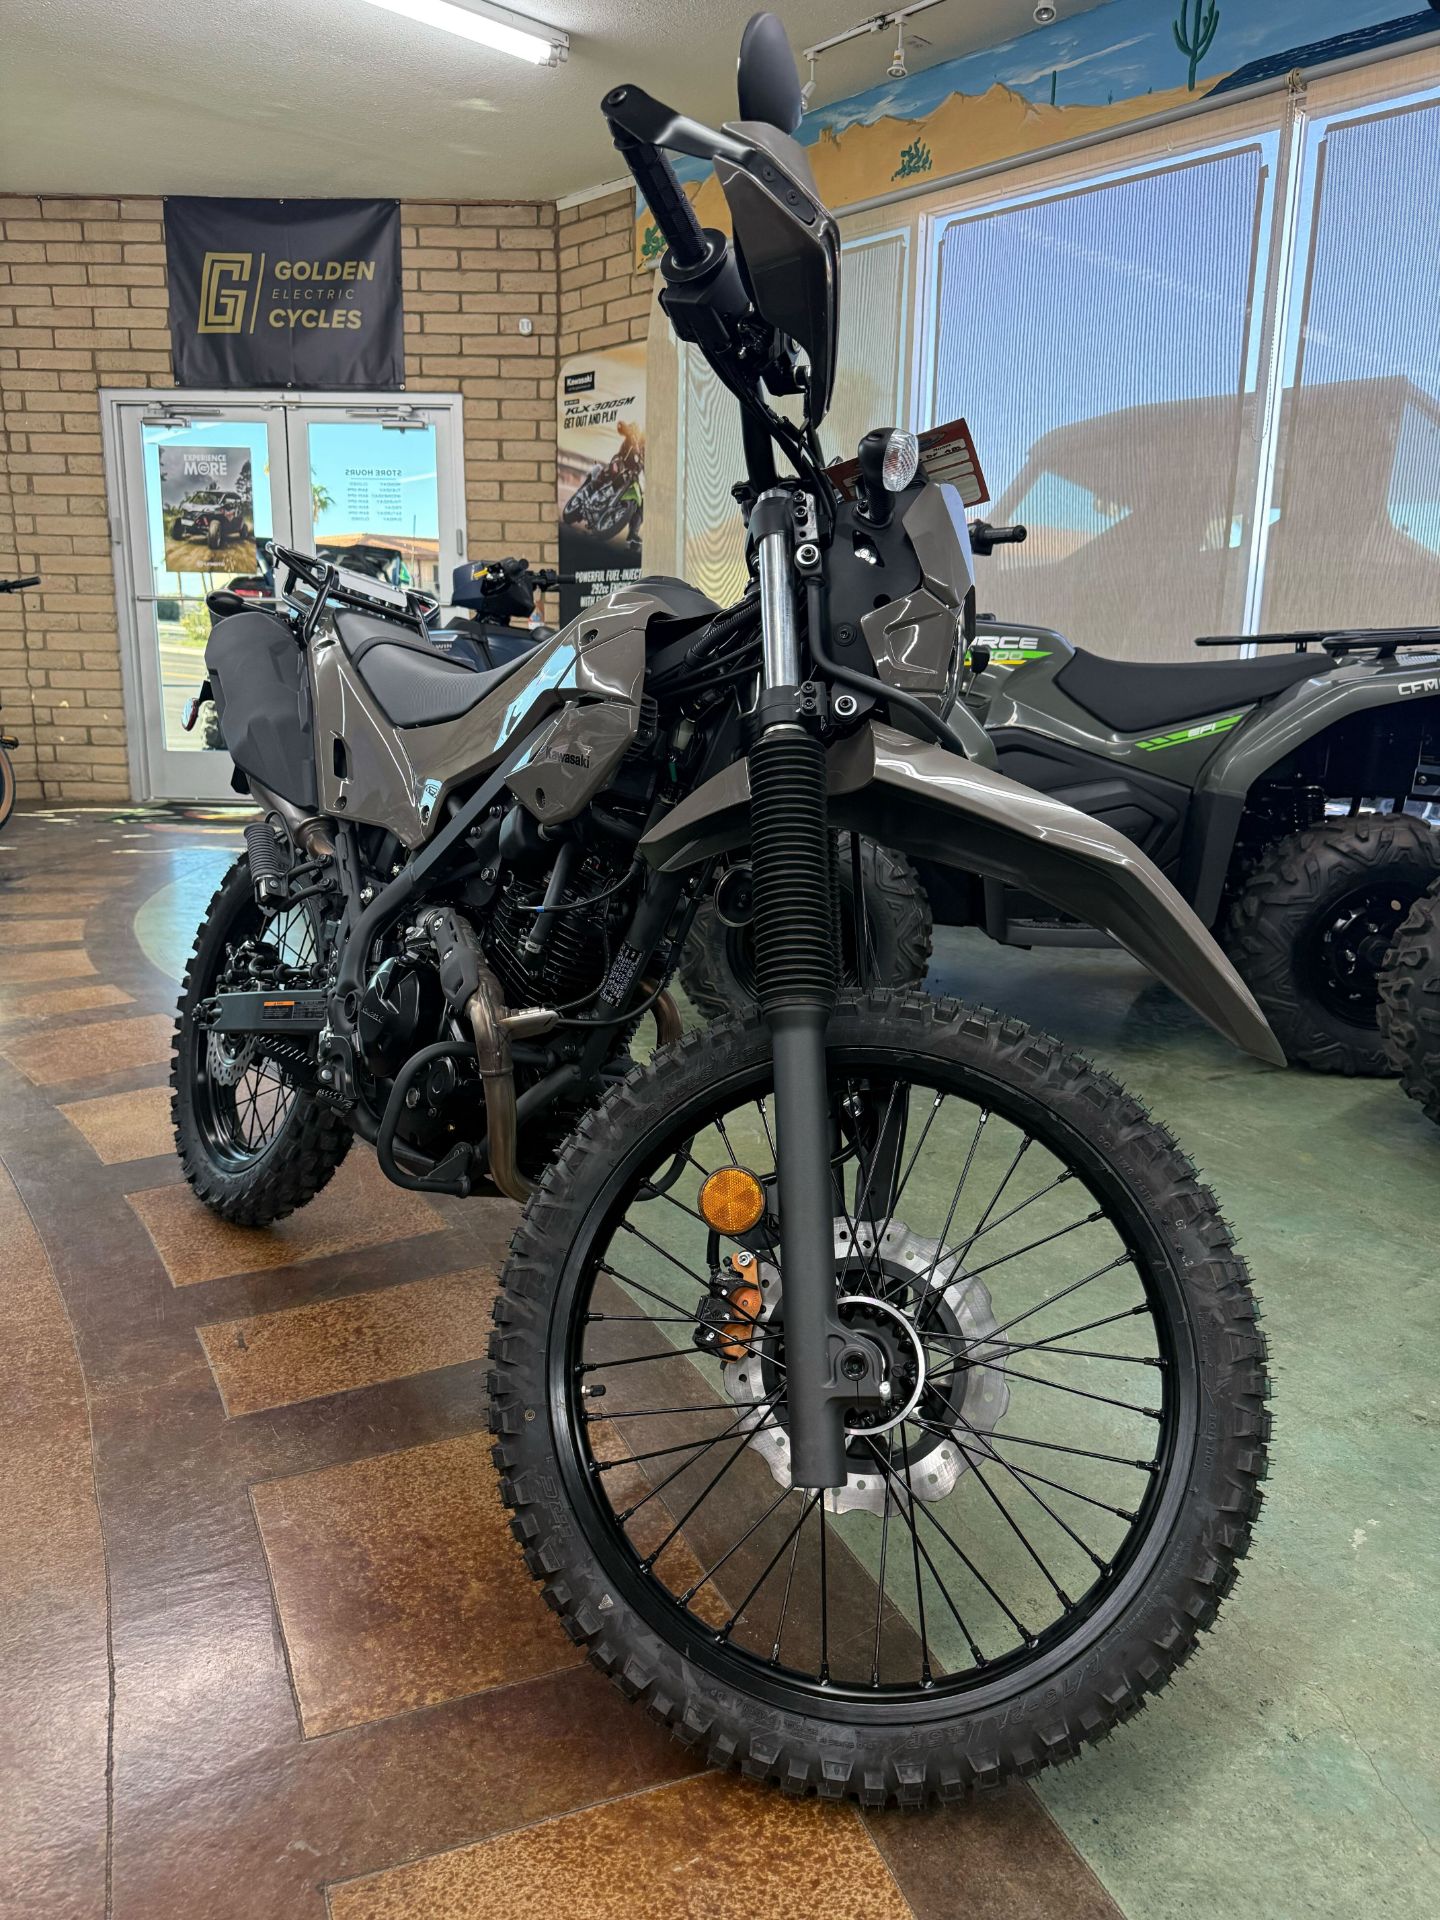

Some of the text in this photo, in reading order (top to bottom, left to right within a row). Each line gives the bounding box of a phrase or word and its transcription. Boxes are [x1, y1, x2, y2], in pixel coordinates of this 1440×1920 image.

[274, 261, 376, 281] GOLDEN
[272, 288, 355, 300] ELECTRIC
[268, 308, 362, 330] CYCLES
[566, 374, 593, 387] Kawasaki
[565, 404, 592, 416] KLX
[592, 396, 636, 412] 300SM
[564, 410, 618, 429] GET OUT AND PLAY
[183, 454, 227, 462] EXPERIENCE
[184, 462, 228, 476] MORE
[575, 570, 605, 583] POWERFUL
[591, 583, 610, 595] 292cc
[989, 650, 1024, 660] 00
[1398, 678, 1440, 696] CFM
[1188, 722, 1216, 738] EFI
[545, 746, 590, 768] Kawasaki
